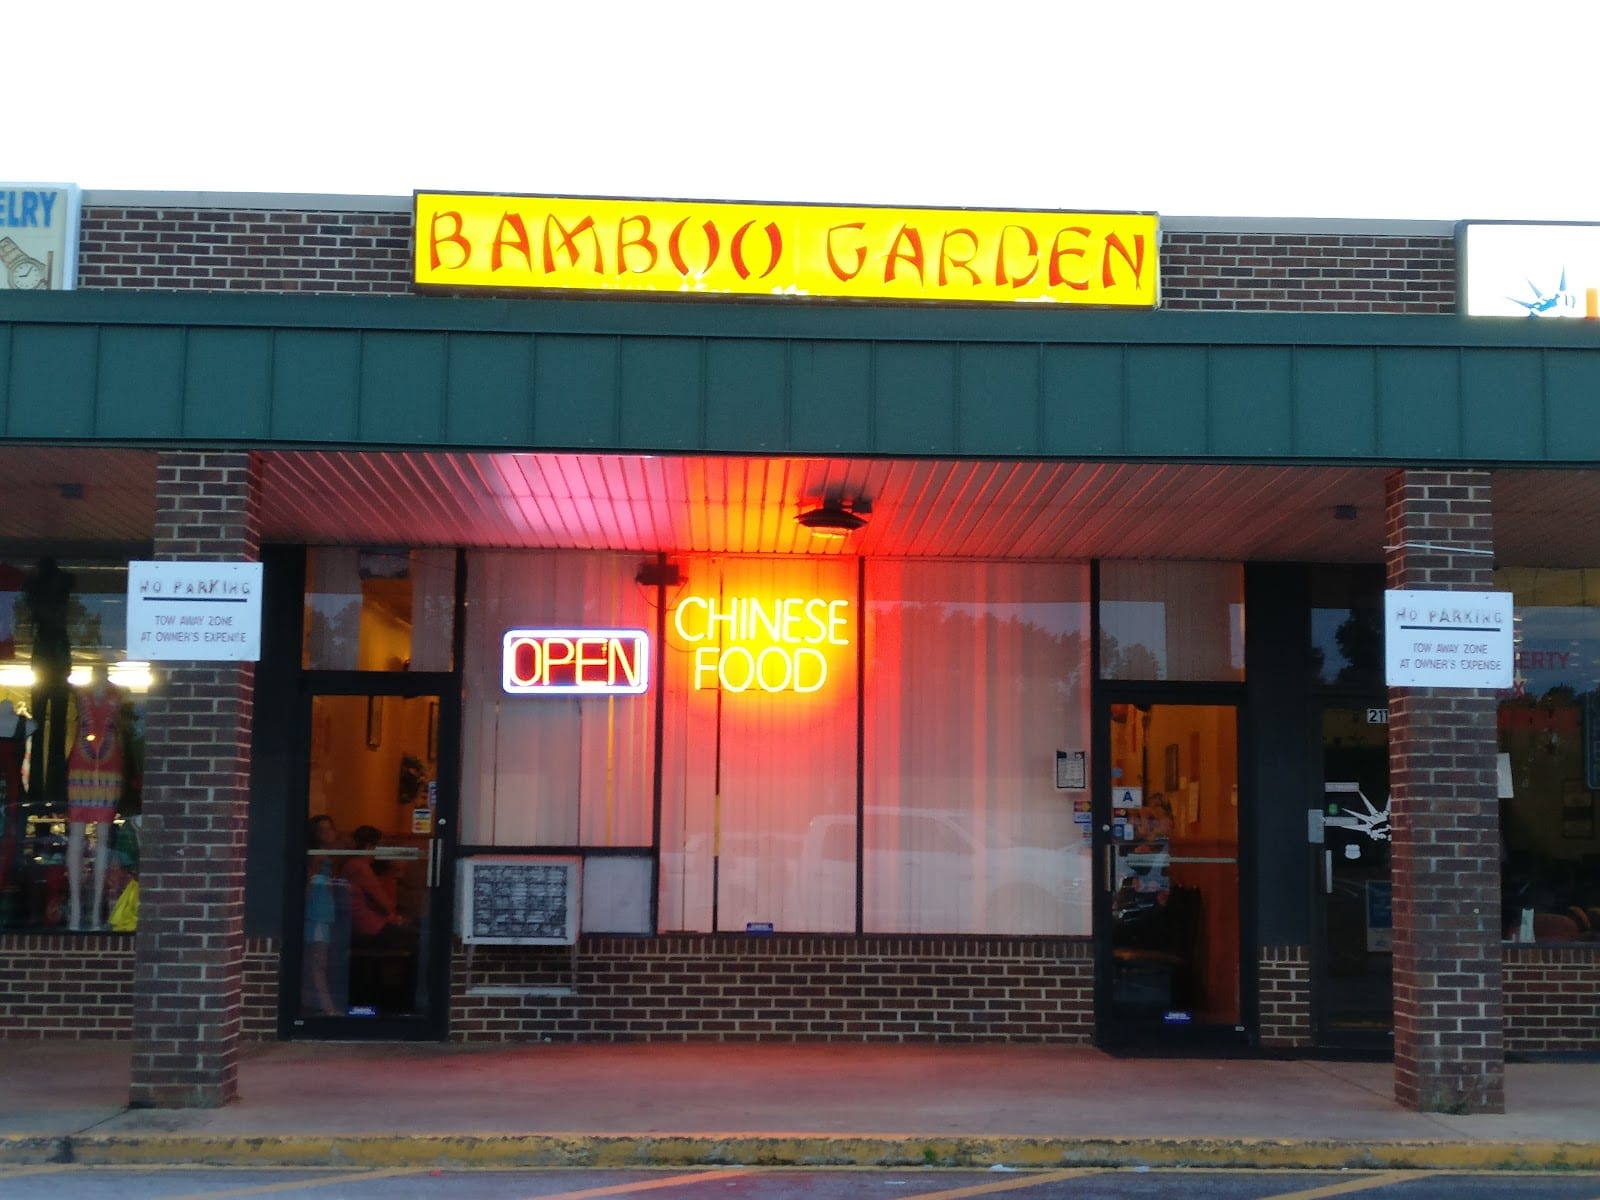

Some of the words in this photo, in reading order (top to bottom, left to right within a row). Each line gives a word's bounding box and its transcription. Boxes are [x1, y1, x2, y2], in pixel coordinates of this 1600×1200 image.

[430, 210, 783, 280] BAMBOO
[827, 222, 1145, 290] GARDEN
[174, 580, 250, 594] PARKING
[155, 615, 176, 626] TOW
[180, 616, 204, 626] AWAY
[208, 616, 233, 626] ZONE
[674, 596, 849, 645] CHINESE
[1429, 609, 1502, 623] PARKING
[141, 631, 152, 641] AT
[155, 631, 200, 643] OWNER'S
[1413, 642, 1433, 653] TOW
[1436, 643, 1460, 653] AWAY
[1464, 643, 1489, 655] ZONE
[510, 637, 641, 687] OPEN
[1400, 658, 1411, 669] AT
[1415, 658, 1456, 671] OWNER'S
[1461, 660, 1502, 671] EXPENSE
[695, 647, 829, 693] FOOD
[1369, 709, 1388, 722] 211
[1122, 790, 1134, 802] A
